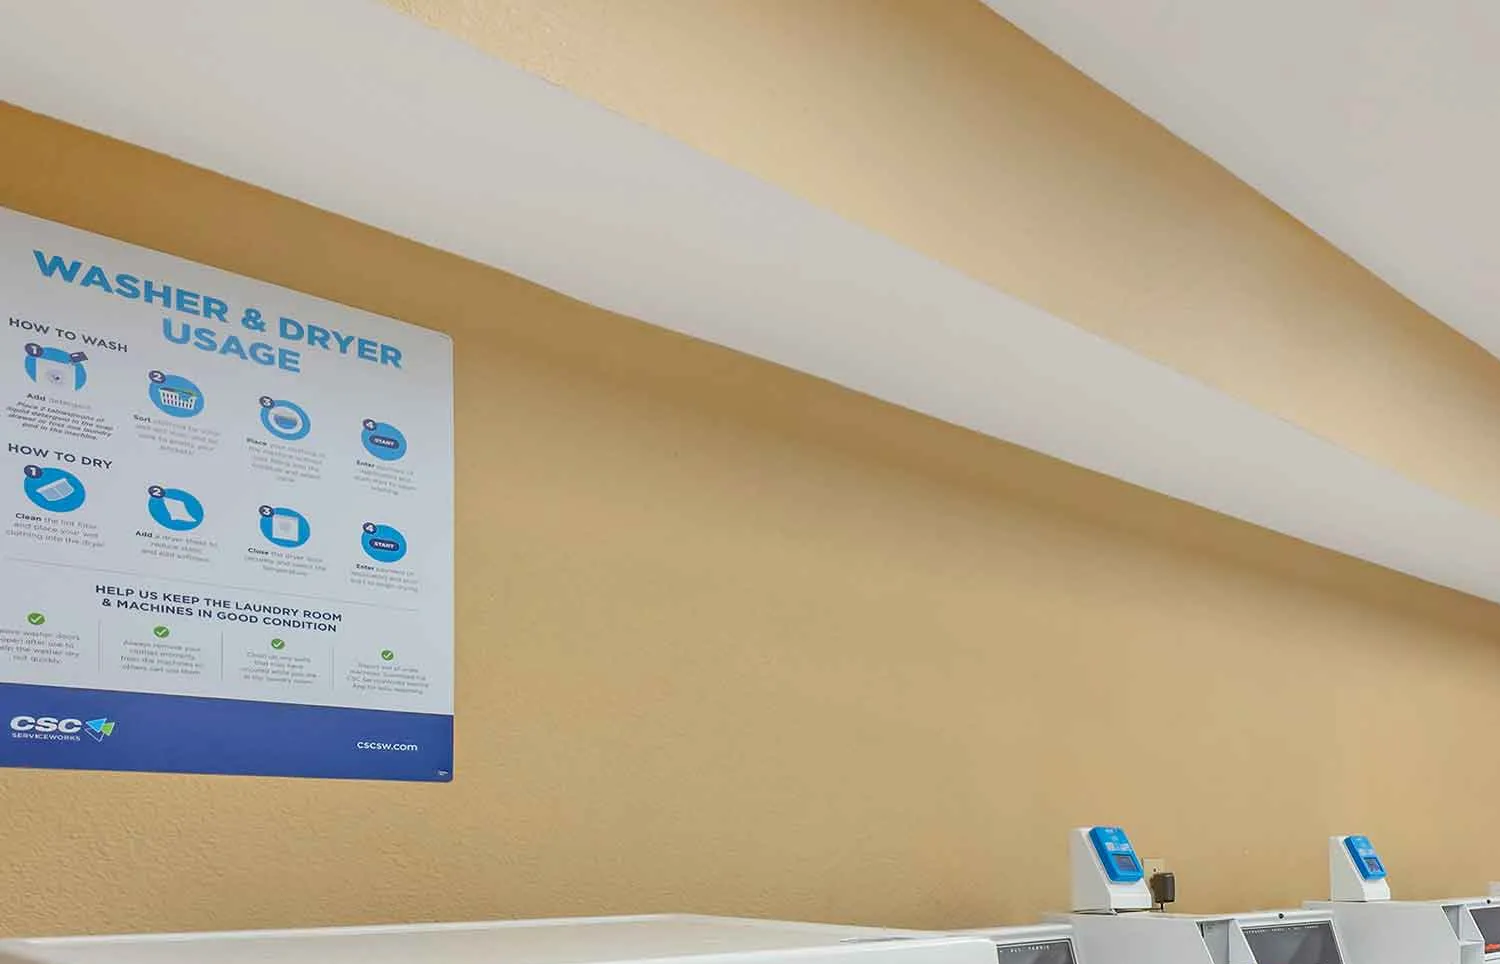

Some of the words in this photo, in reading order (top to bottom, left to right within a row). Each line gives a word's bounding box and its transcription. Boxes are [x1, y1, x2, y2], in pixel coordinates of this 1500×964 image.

[33, 249, 229, 323] WASHER
[241, 308, 266, 333] &
[279, 317, 403, 369] DRYER
[9, 317, 50, 335] HOW
[55, 328, 76, 341] TO
[82, 334, 128, 353] WASH
[162, 317, 301, 373] USAGE
[26, 393, 46, 401] Add
[133, 414, 151, 423] Sort
[8, 443, 49, 458] HOW
[54, 451, 76, 463] TO
[81, 456, 113, 469] DRY
[15, 512, 42, 522] Clean
[135, 530, 153, 538] Add
[95, 584, 135, 597] HELP
[138, 590, 158, 601] US
[162, 592, 200, 605] KEEP
[203, 598, 231, 609] THE
[235, 602, 299, 618] LAUNDRY
[303, 610, 343, 622] ROOM
[102, 598, 112, 608] &
[117, 600, 194, 616] MACHINES
[198, 609, 212, 619] IN
[216, 611, 259, 624] GOOD
[262, 617, 338, 633] CONDITION
[10, 716, 82, 733] CSC
[12, 732, 81, 741] SERVICEWORKS
[357, 741, 418, 751] cscsw.com
